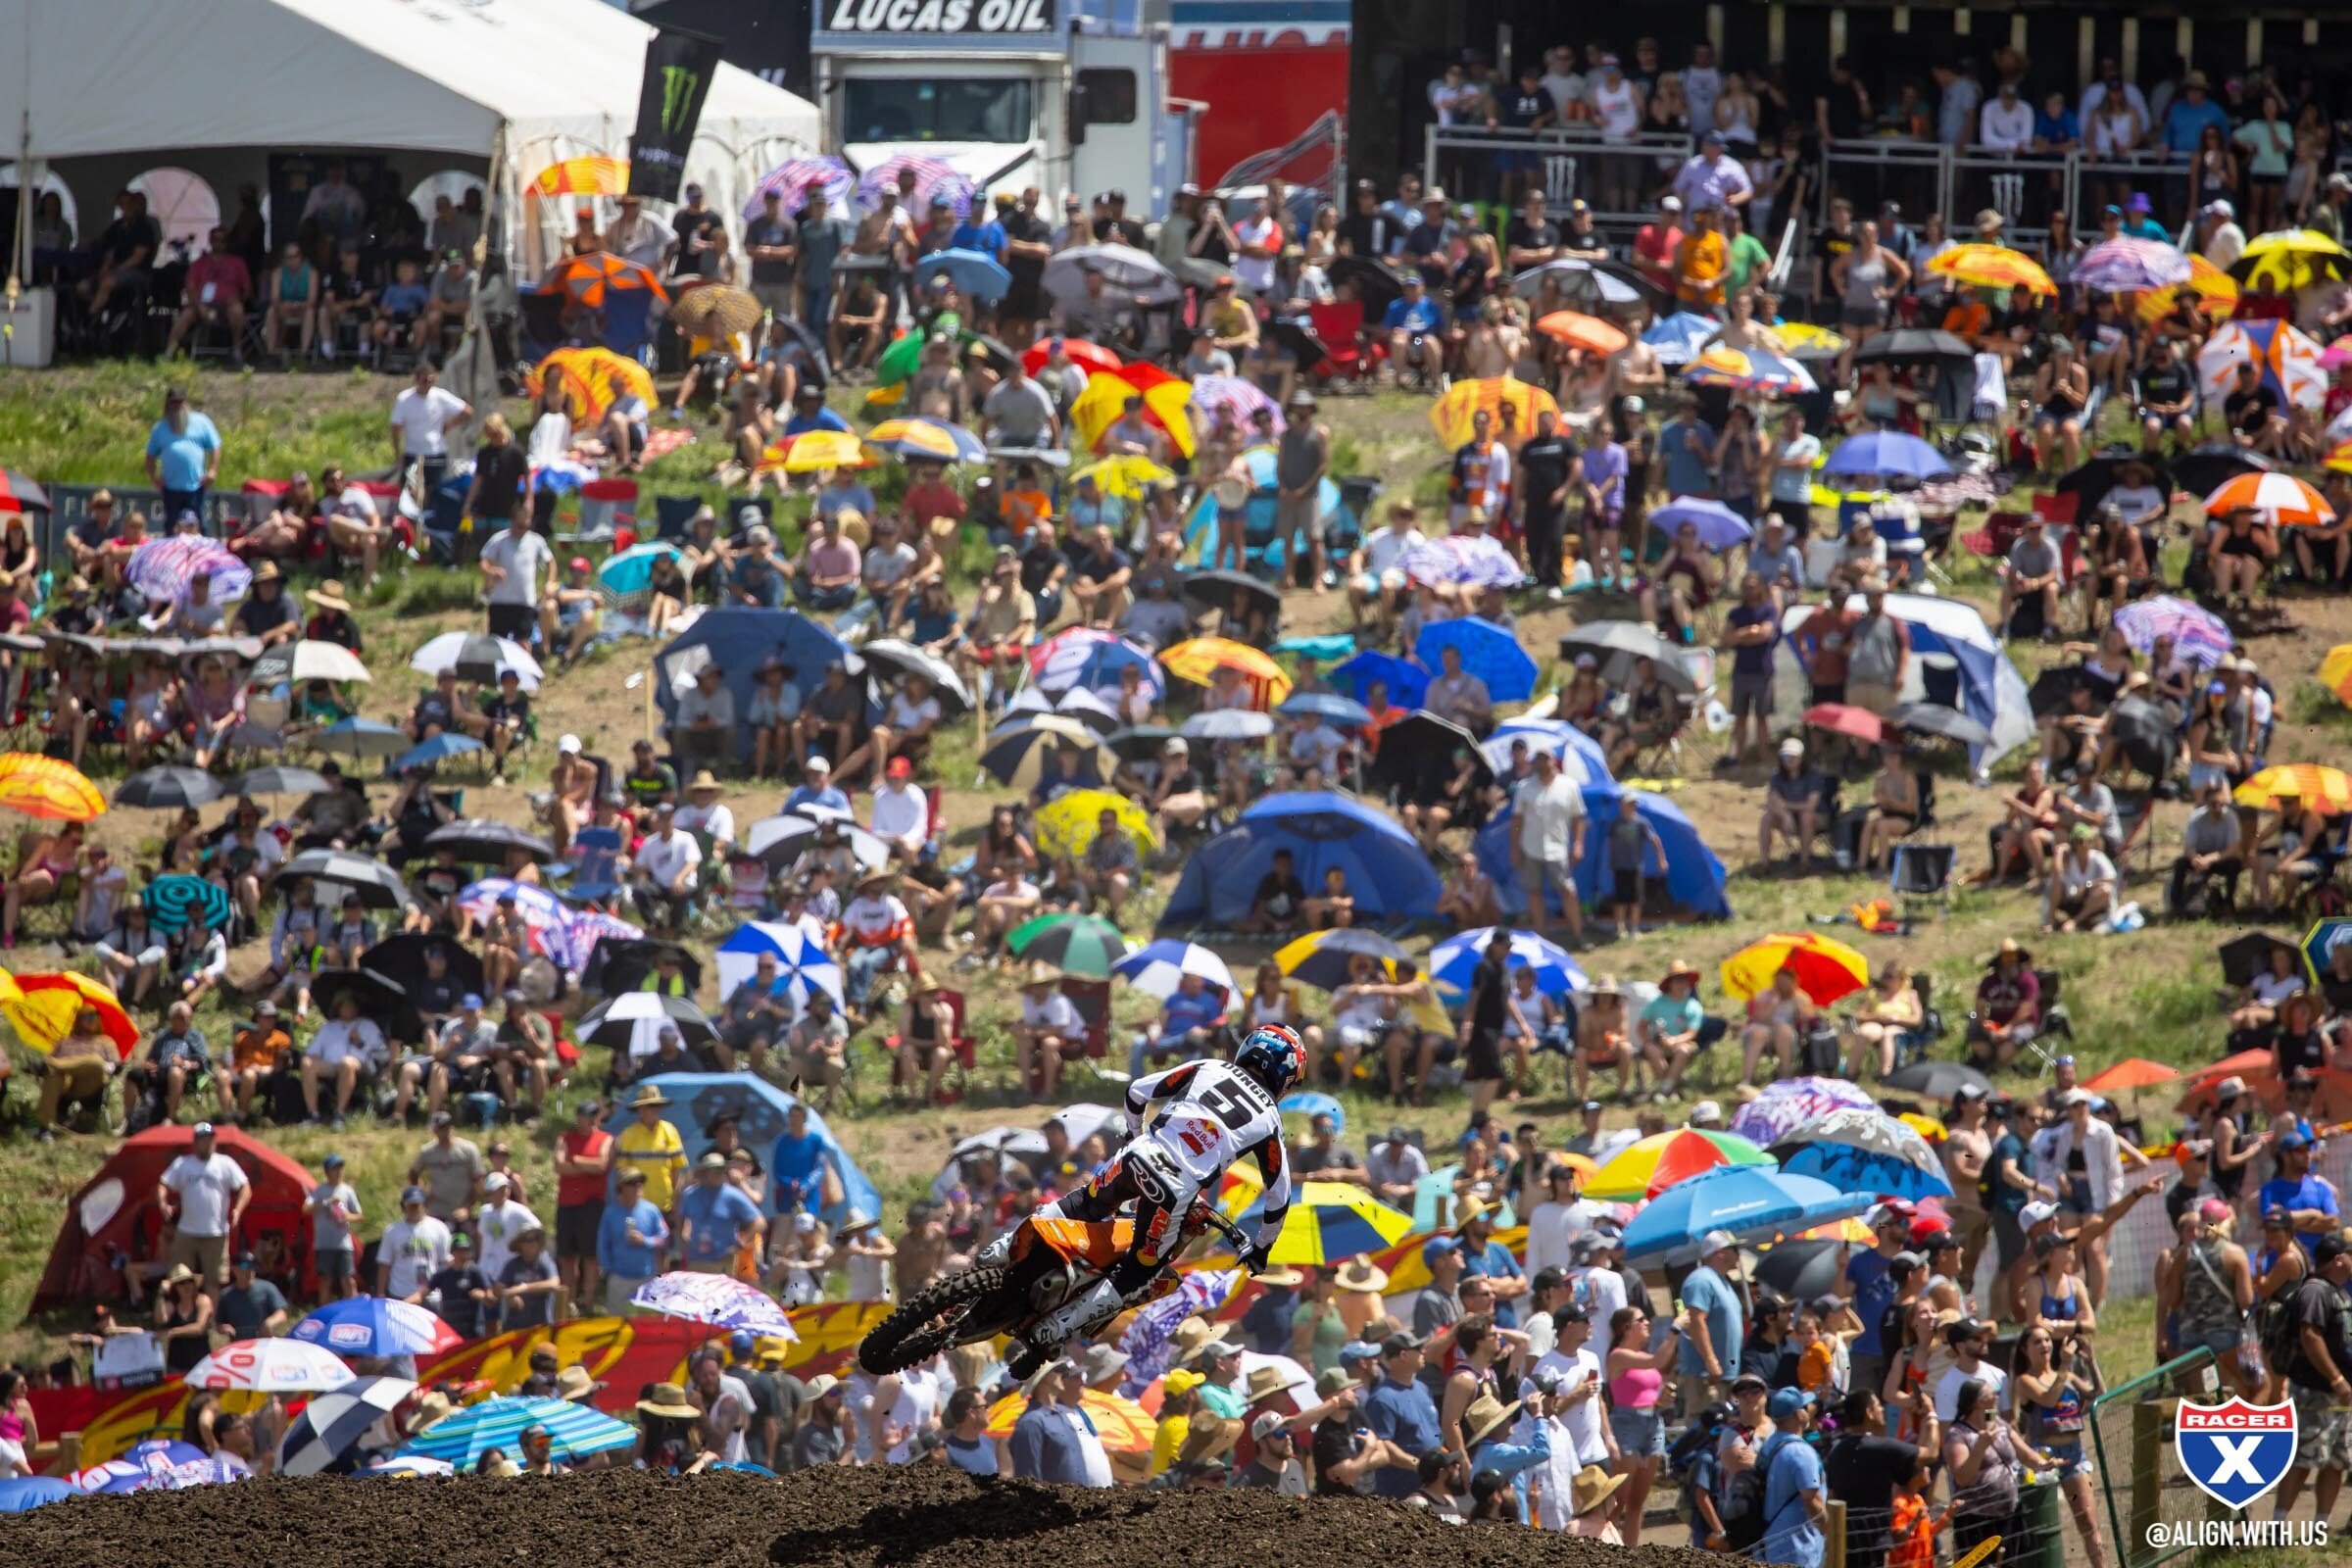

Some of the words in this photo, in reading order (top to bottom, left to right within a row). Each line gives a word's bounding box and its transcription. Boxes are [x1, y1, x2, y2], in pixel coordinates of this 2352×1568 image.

[829, 0, 973, 32] LUCAS
[978, 0, 1047, 32] OIL
[1199, 1077, 1264, 1131] 5
[1221, 1062, 1275, 1108] DUNGEY
